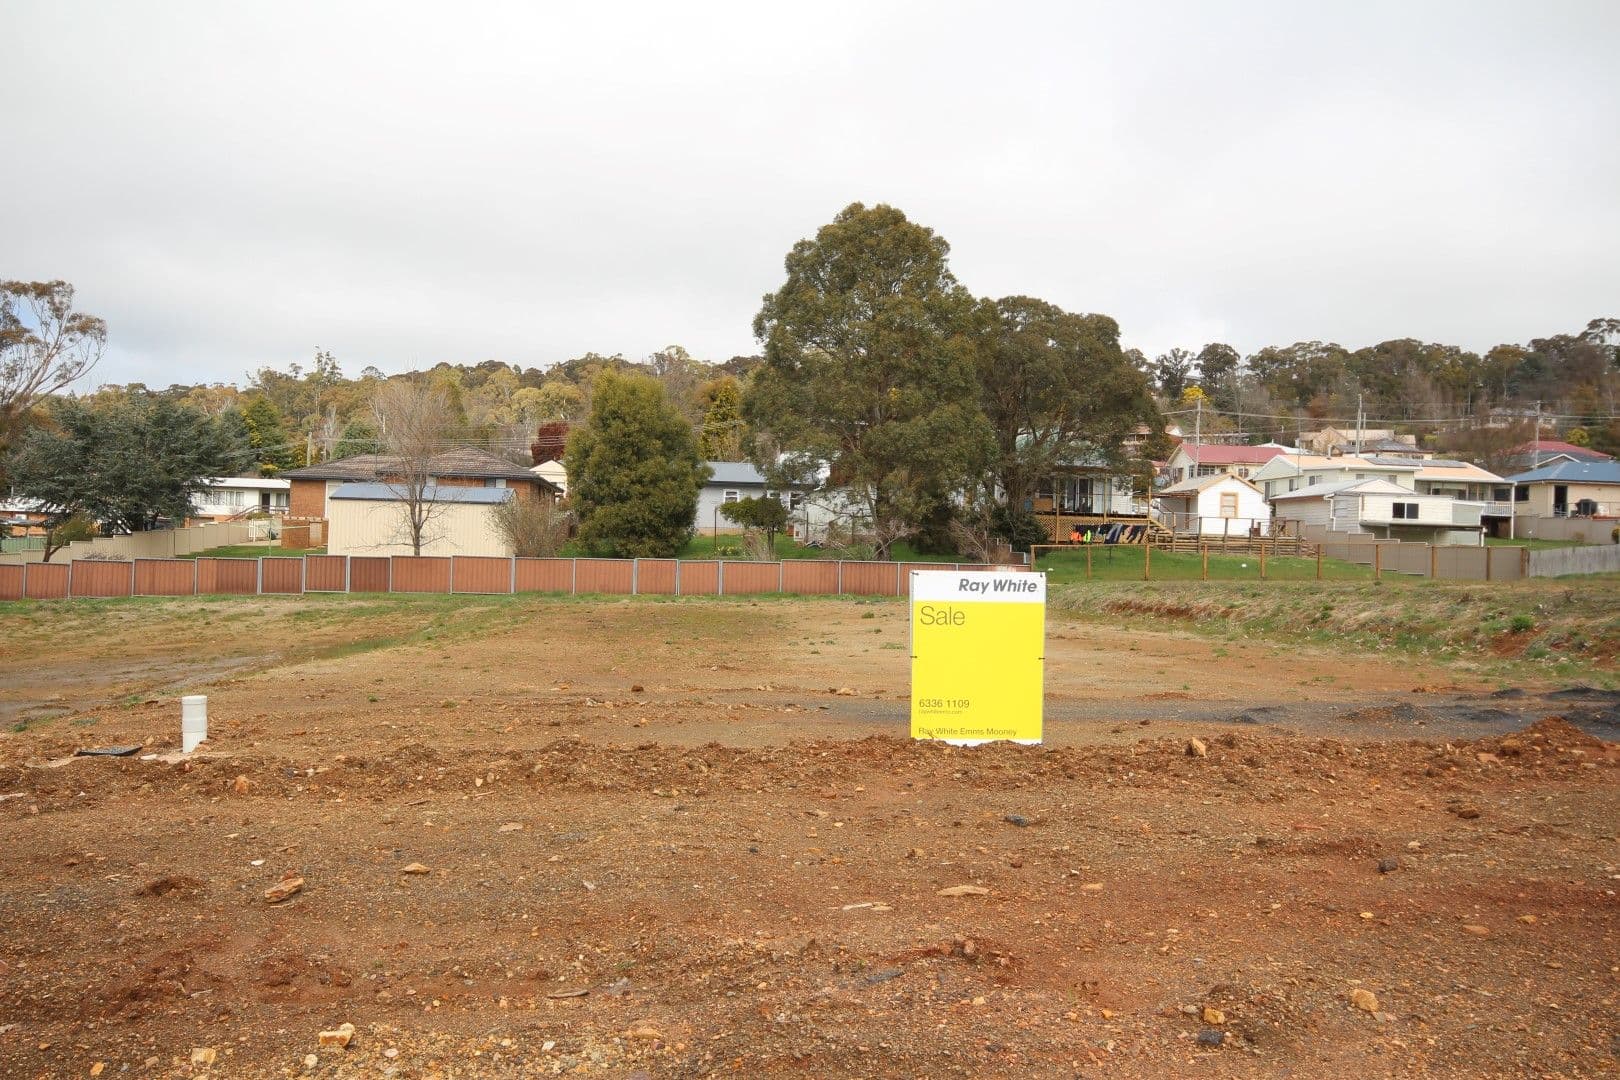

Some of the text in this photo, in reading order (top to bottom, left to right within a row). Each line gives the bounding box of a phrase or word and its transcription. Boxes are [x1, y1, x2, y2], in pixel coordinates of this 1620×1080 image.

[959, 578, 1037, 594] Ray White
[920, 605, 966, 626] Sale
[919, 699, 970, 708] 6336 1109
[918, 727, 934, 736] Ray
[935, 727, 958, 736] White
[987, 728, 1017, 737] Mooney
